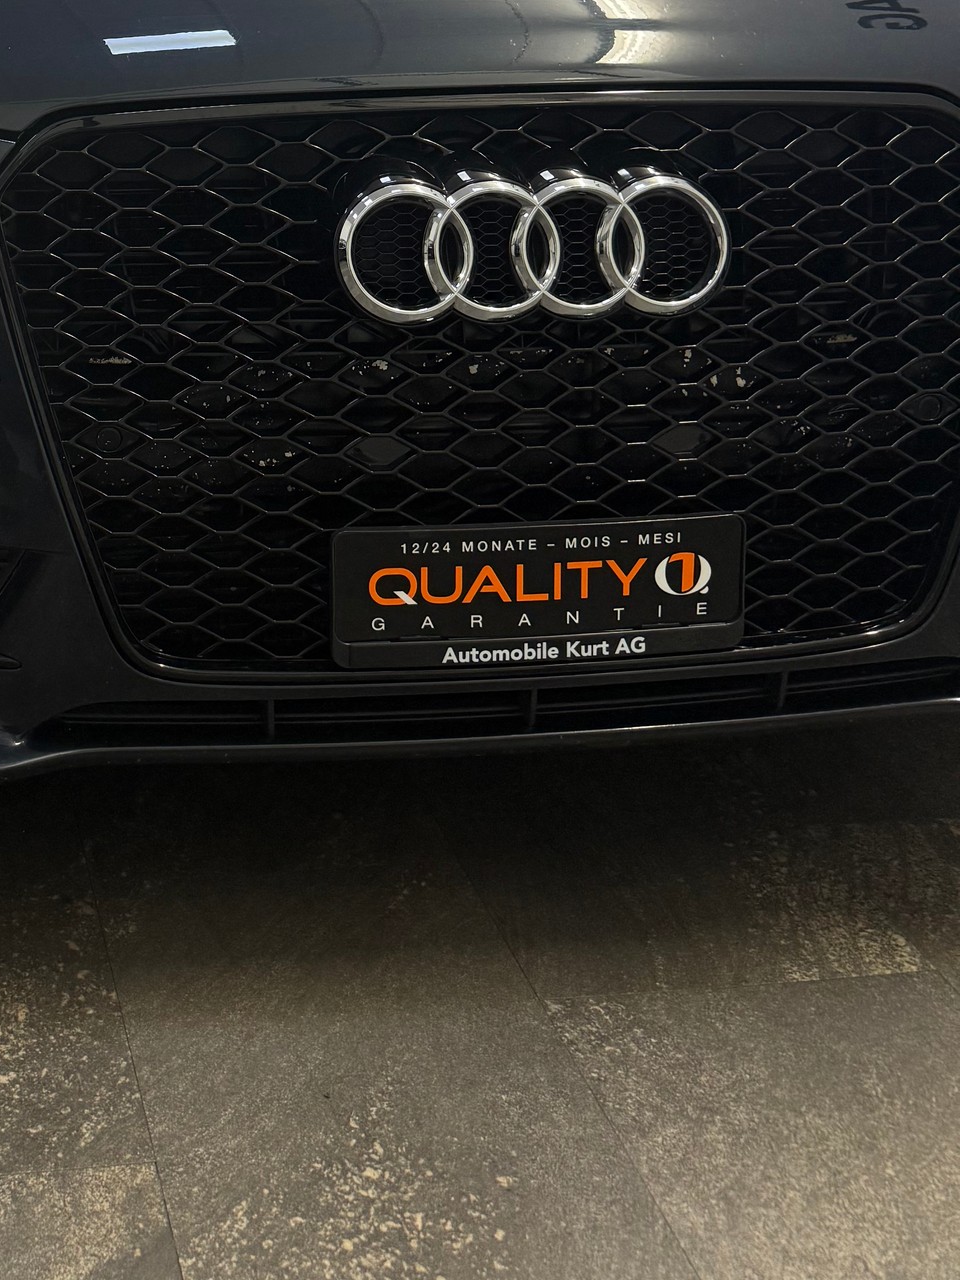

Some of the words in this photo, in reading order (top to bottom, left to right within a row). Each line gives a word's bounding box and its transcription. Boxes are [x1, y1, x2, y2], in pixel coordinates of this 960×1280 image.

[401, 542, 451, 555] 12/24
[462, 539, 538, 553] MONATE
[565, 535, 611, 548] MOIS
[638, 532, 682, 545] MESI
[368, 558, 648, 606] QUALITY
[371, 602, 708, 631] GARANTIE
[442, 642, 559, 664] Automobile
[566, 640, 609, 658] Kurt
[615, 636, 646, 654] AG
